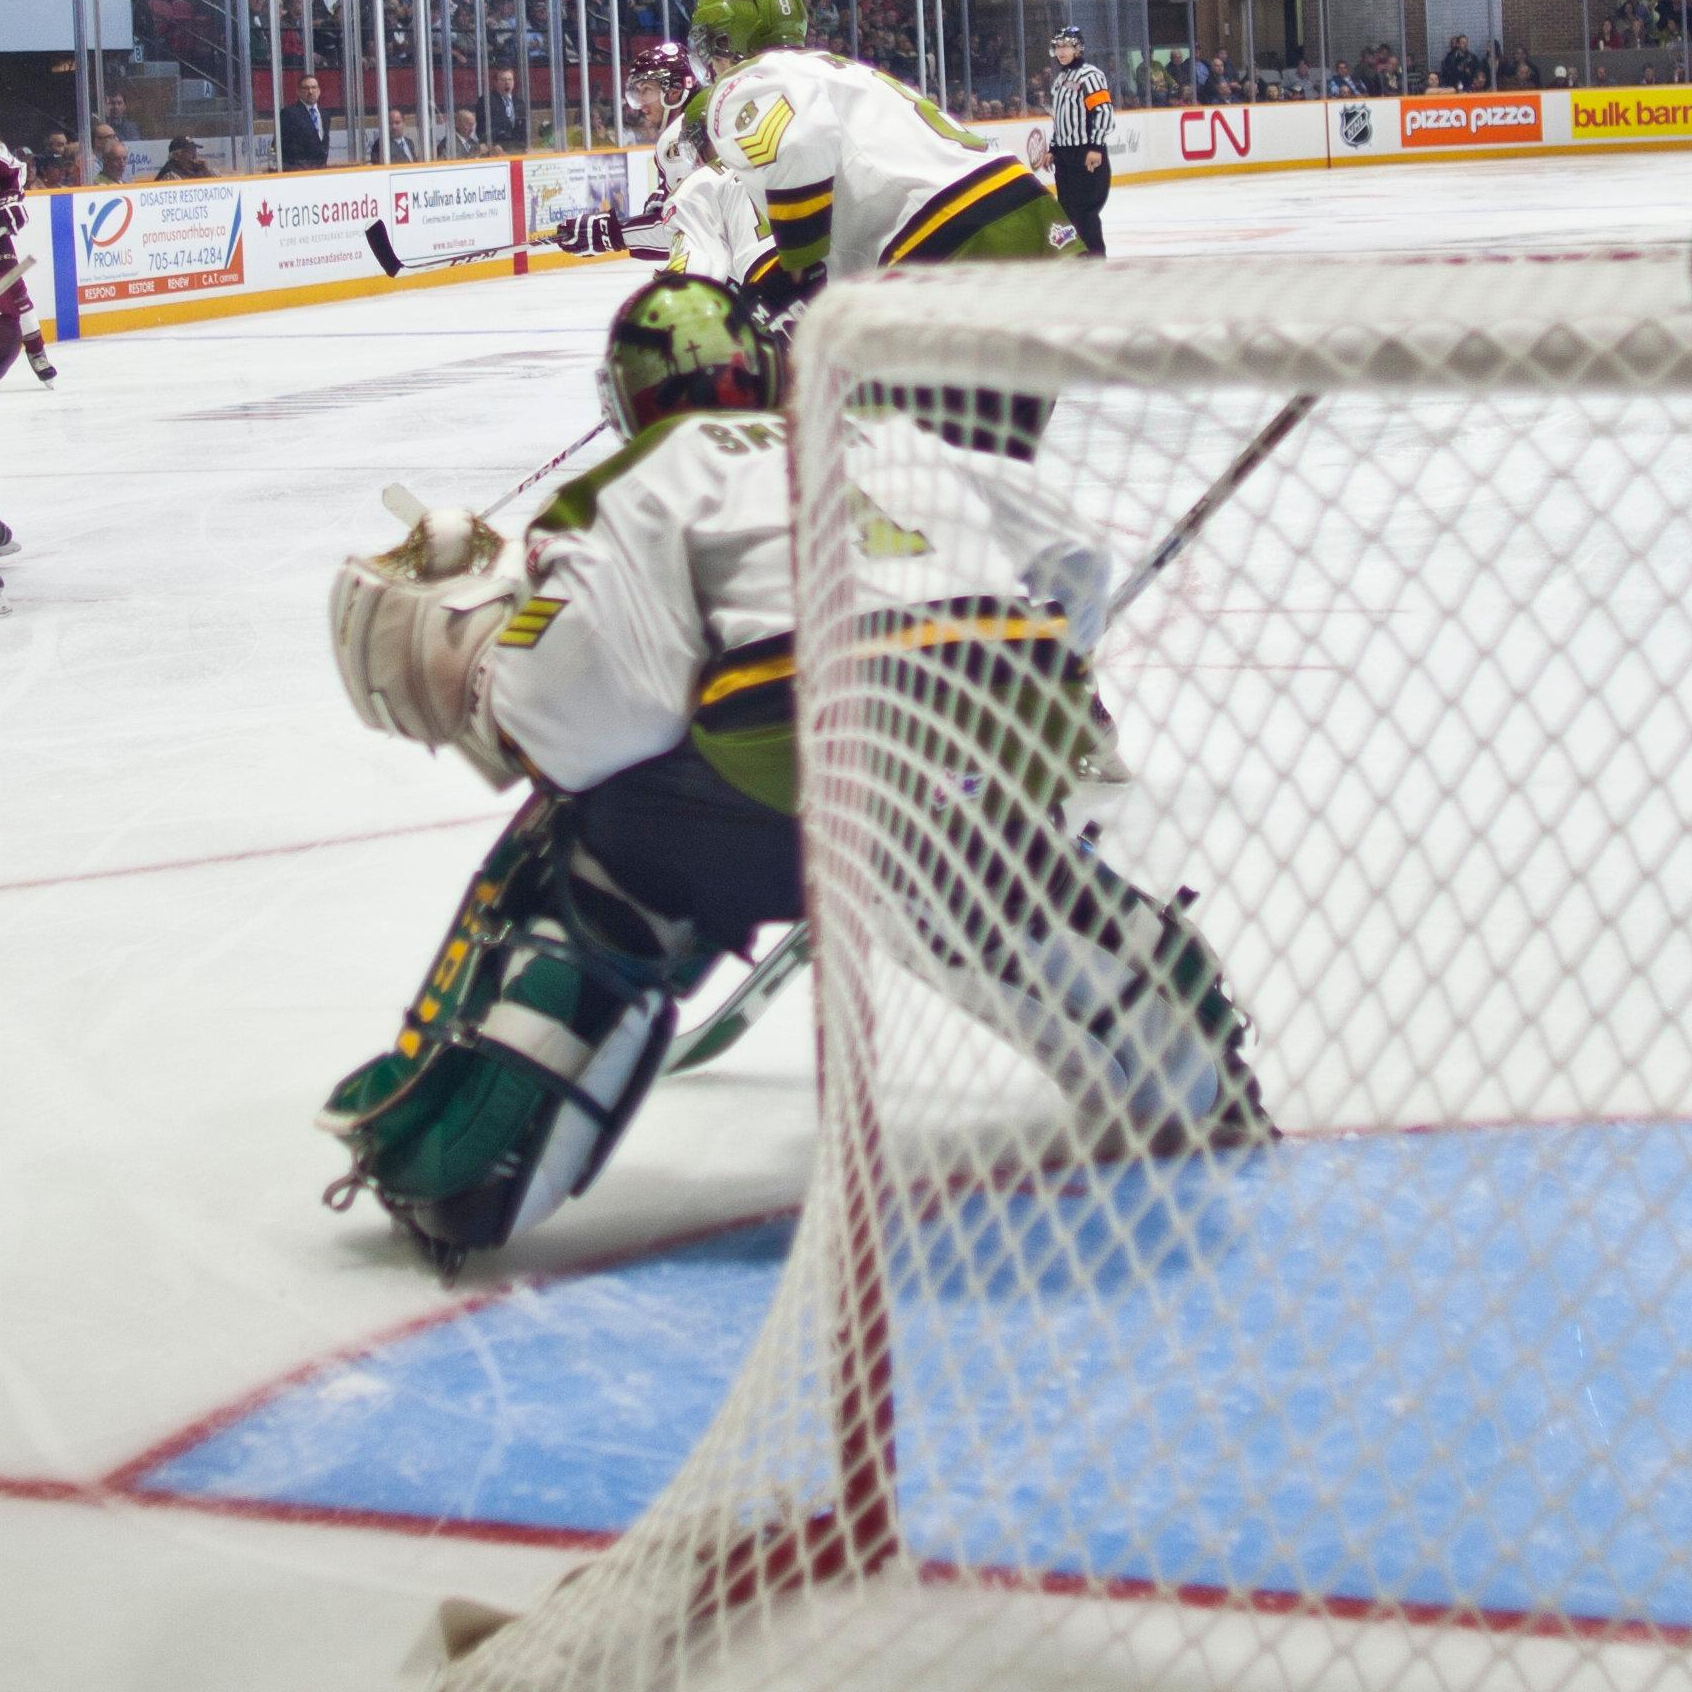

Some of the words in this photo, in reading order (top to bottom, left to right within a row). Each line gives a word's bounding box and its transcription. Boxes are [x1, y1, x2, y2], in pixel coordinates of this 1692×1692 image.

[1406, 108, 1467, 137] pizza
[1470, 104, 1536, 134] pizza
[1573, 101, 1631, 129] bulk
[1180, 107, 1251, 161] CN
[140, 191, 178, 208] DISASTER
[179, 186, 234, 203] RESTORATION
[412, 193, 422, 209] M.
[423, 189, 454, 208] Sullivan
[455, 188, 462, 204] &
[463, 187, 477, 204] Son
[478, 184, 506, 202] Limited
[161, 206, 208, 223] SPECIALISTS
[277, 193, 379, 229] transcanada
[142, 222, 226, 248] promusnorthbay.ca
[94, 249, 133, 269] PROMUS
[148, 246, 222, 272] 705-474-4284
[278, 250, 363, 270] www.transcanadastore.ca
[85, 285, 117, 300] RESPOND
[128, 281, 156, 295] RESTORE
[167, 277, 190, 290] RENEW
[517, 450, 569, 494] CCM
